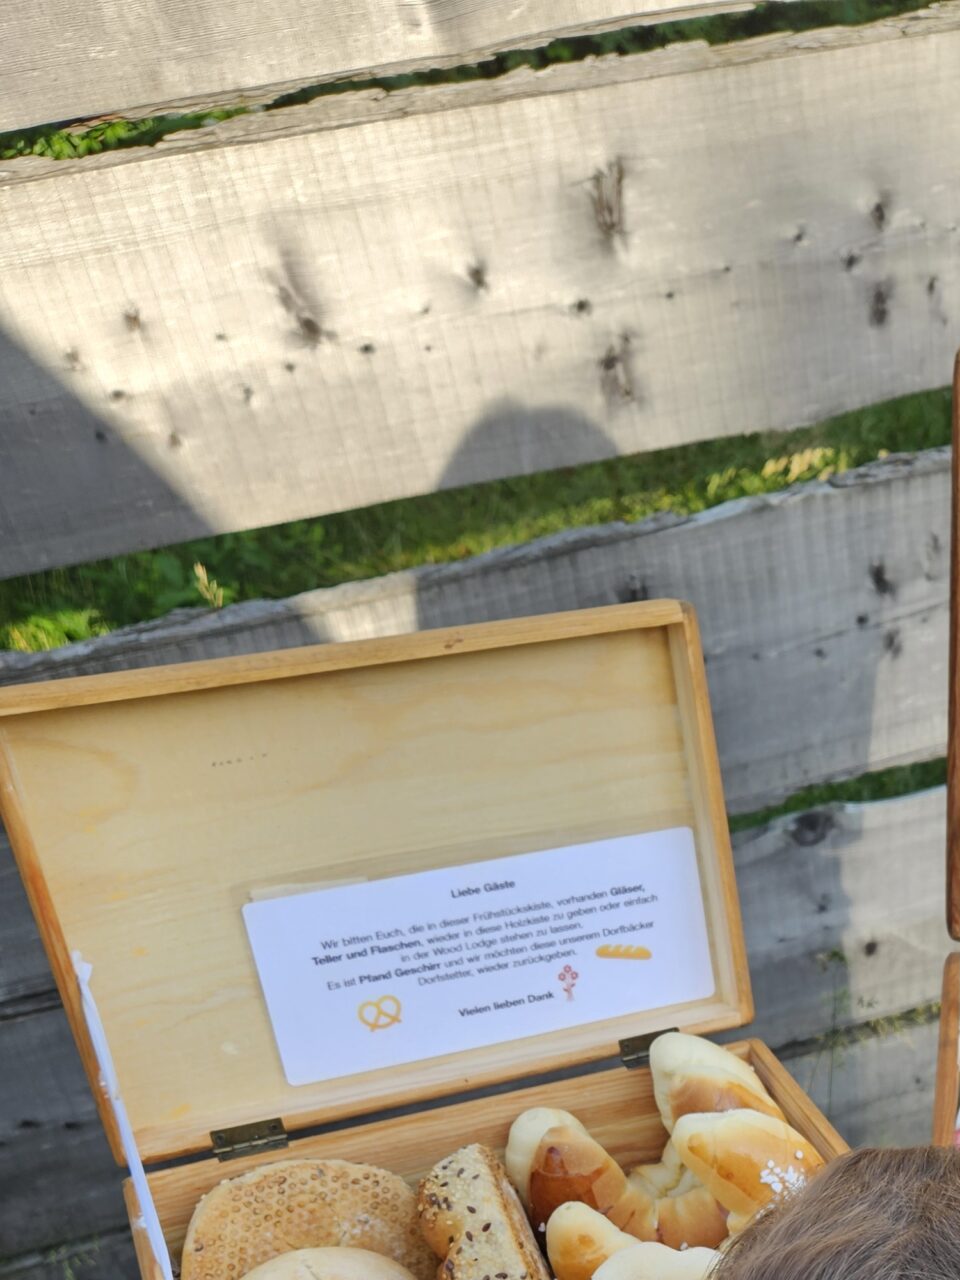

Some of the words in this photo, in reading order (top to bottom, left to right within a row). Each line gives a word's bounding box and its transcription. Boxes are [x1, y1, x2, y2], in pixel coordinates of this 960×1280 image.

[450, 885, 481, 898] Liebe
[484, 879, 515, 892] Gäste
[312, 954, 343, 966] Teller
[347, 949, 368, 959] und
[371, 940, 423, 955] Flaschen,
[426, 932, 460, 944] wieder
[463, 929, 473, 938] in
[475, 924, 502, 935] diese
[505, 914, 550, 929] Holzkiste
[567, 905, 597, 919] geben
[599, 901, 621, 912] oder
[623, 894, 658, 908] einfach
[321, 940, 338, 950] Wir
[342, 934, 373, 947] bitten
[376, 928, 405, 941] Euch,
[408, 924, 425, 934] die
[427, 921, 437, 931] in
[439, 917, 469, 928] dieser
[473, 902, 554, 922] Frühstückskiste,
[556, 889, 607, 906] vorhanden
[610, 884, 645, 897] Gläser,
[326, 981, 341, 991] Es
[344, 977, 357, 987] ist
[359, 970, 392, 984] Pfand
[394, 963, 442, 977] Geschirr
[444, 957, 465, 967] und
[467, 955, 481, 964] wir
[484, 944, 528, 959] möchten
[530, 939, 556, 951] diese
[558, 932, 600, 945] unserem
[602, 920, 654, 937] Dorfbäcker
[401, 954, 410, 962] in
[413, 950, 430, 960] der
[433, 942, 463, 956] Wood
[465, 937, 497, 951] Lodge
[500, 931, 533, 944] stehen
[536, 929, 548, 937] zu
[550, 922, 583, 934] lassen.
[476, 960, 509, 974] wieder
[512, 949, 577, 967] zurückgeben.
[459, 1004, 491, 1017] Vielen
[493, 998, 525, 1010] lieben
[528, 991, 555, 1003] Dank
